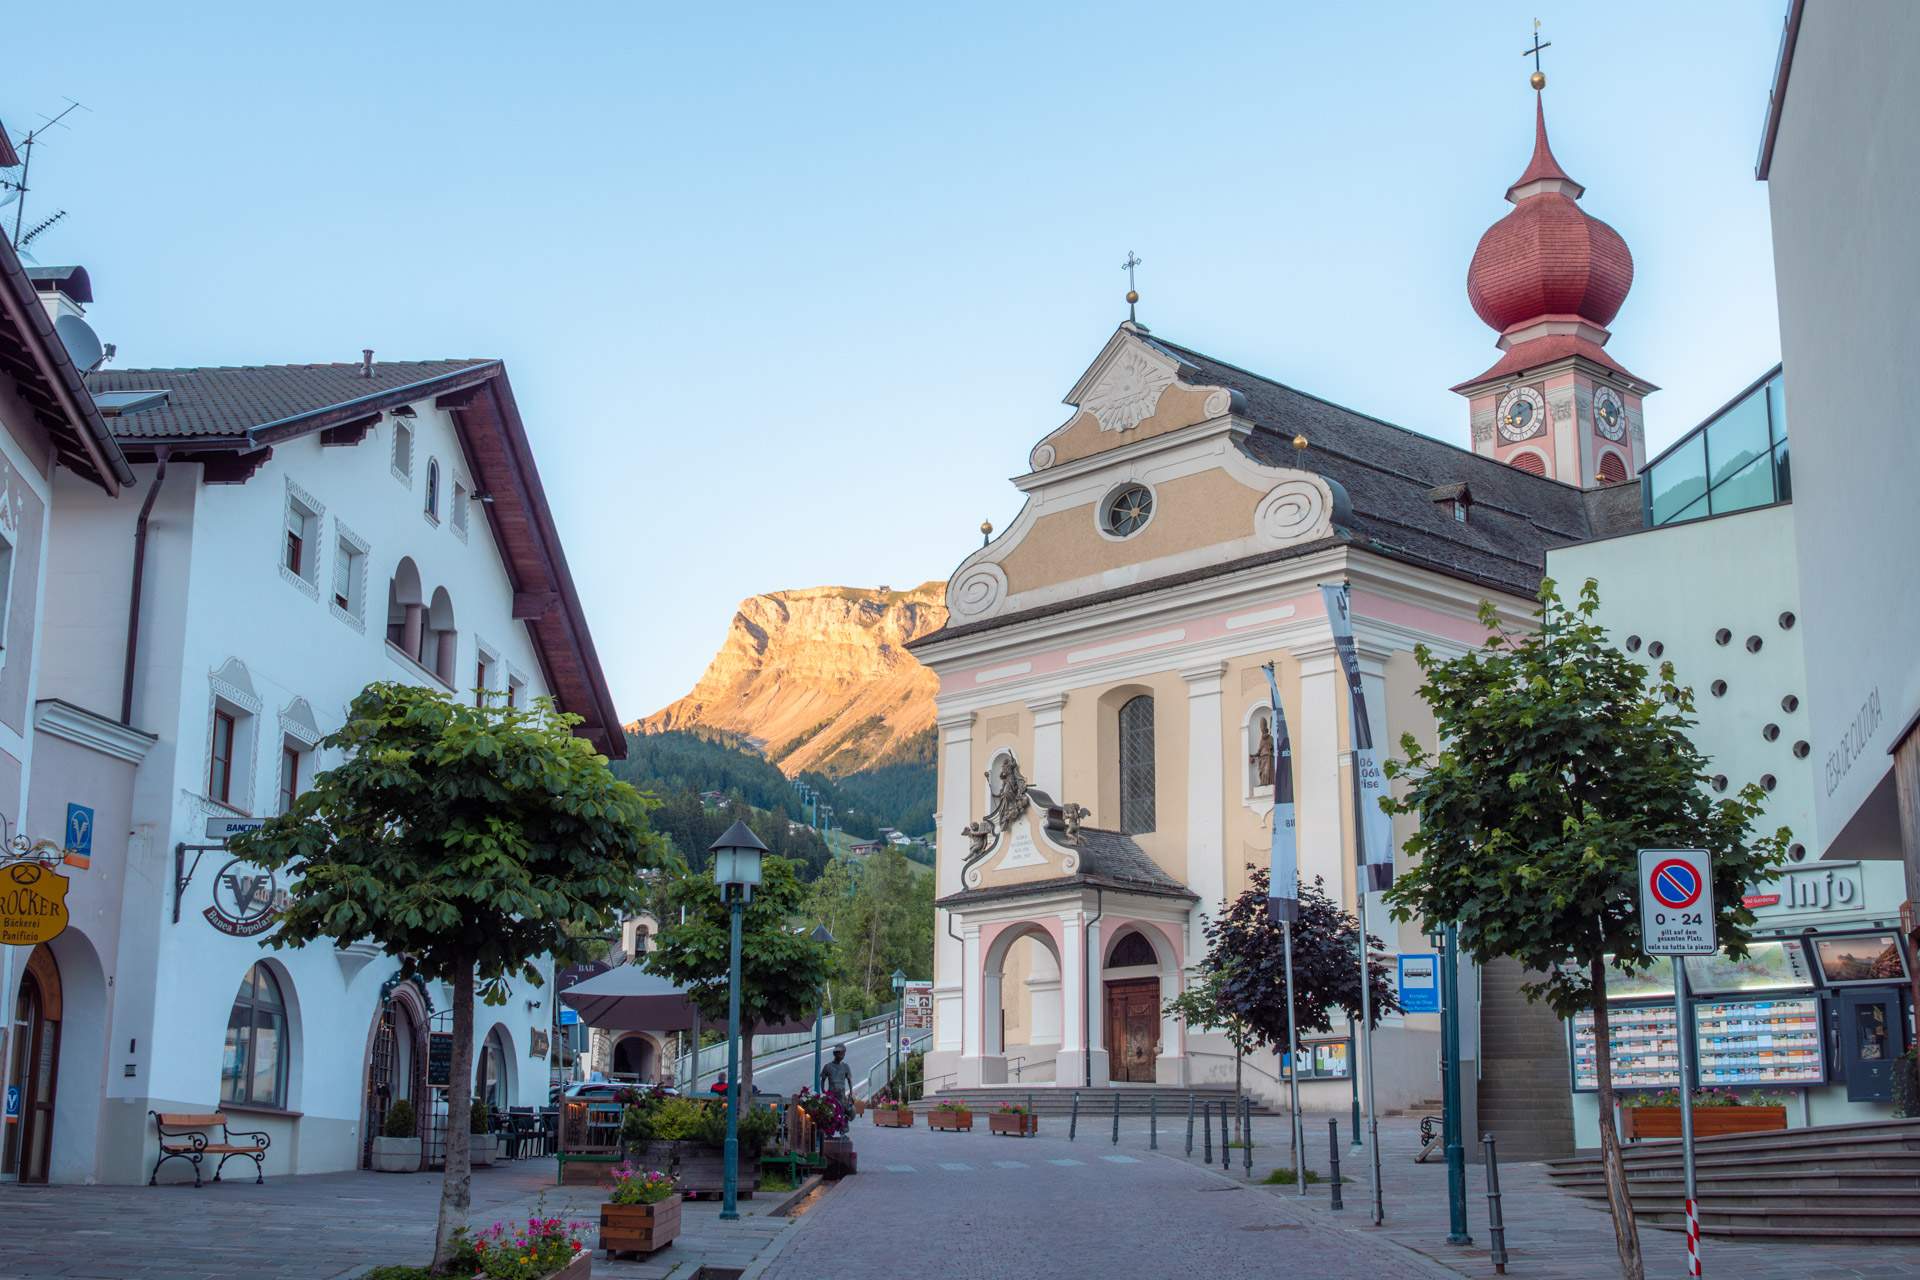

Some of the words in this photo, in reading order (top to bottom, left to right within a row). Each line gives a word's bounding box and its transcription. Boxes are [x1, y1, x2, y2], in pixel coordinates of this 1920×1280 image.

[1850, 685, 1883, 761] CULTURA
[1784, 870, 1854, 909] Info
[207, 910, 233, 932] Banca
[1681, 913, 1703, 925] 24
[2, 930, 39, 941] Panificio
[578, 964, 594, 972] BAR
